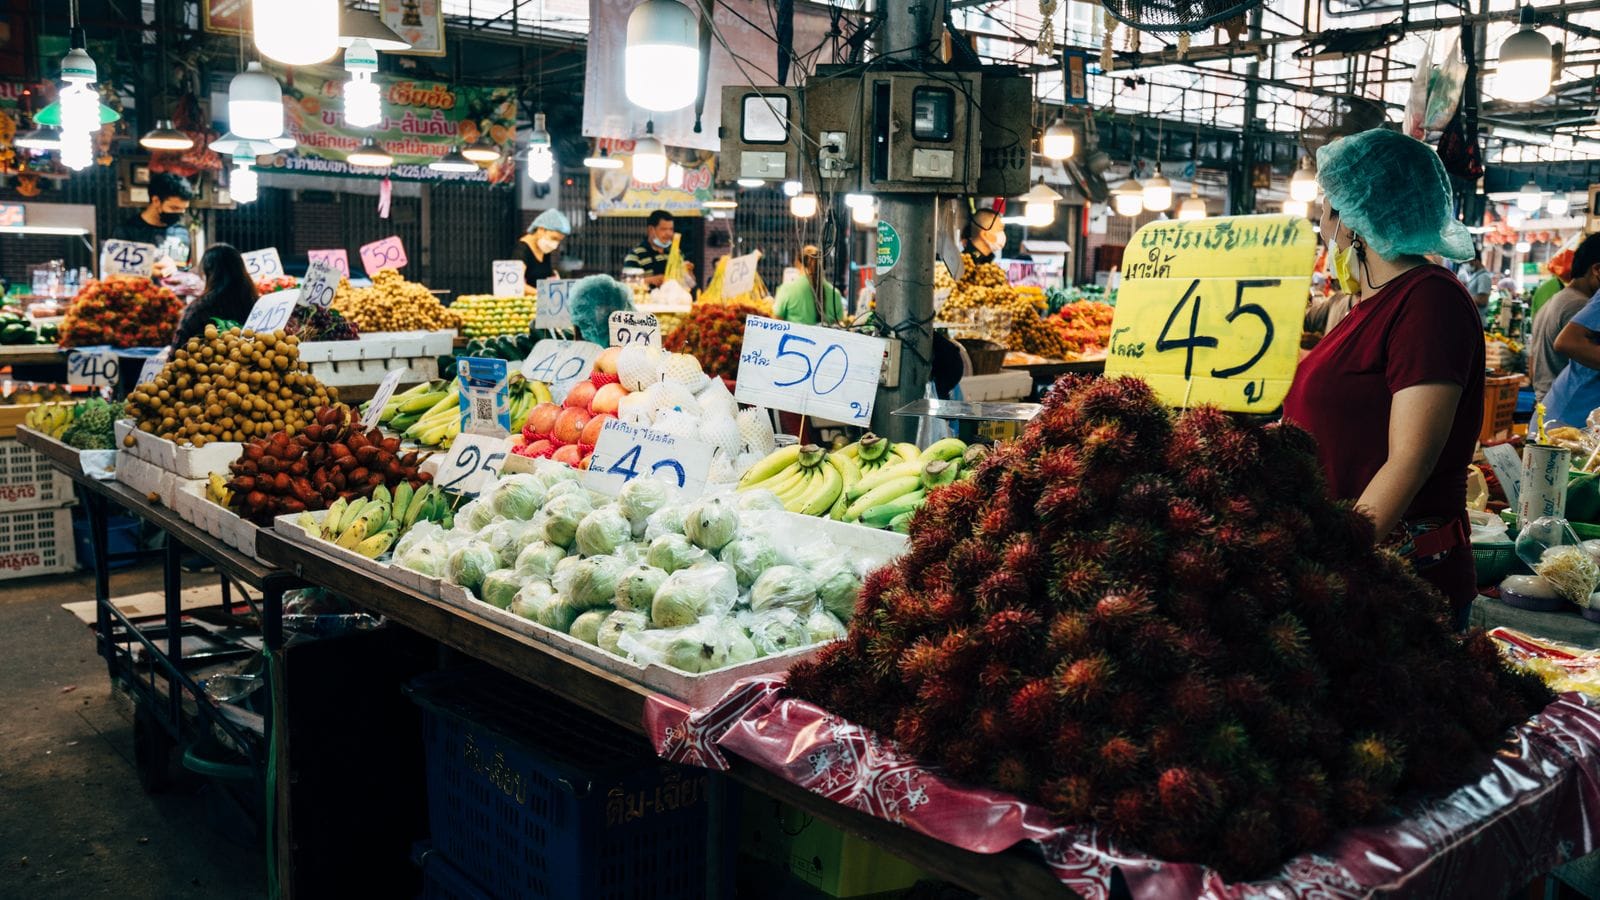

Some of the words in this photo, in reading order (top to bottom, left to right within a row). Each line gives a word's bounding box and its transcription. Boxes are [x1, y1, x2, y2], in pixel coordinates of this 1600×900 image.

[114, 247, 147, 268] 45
[247, 252, 277, 275] 35
[373, 246, 400, 268] 50
[496, 270, 519, 286] 70
[255, 301, 289, 333] 45
[1156, 279, 1282, 381] 45
[81, 355, 118, 385] 40
[532, 352, 585, 381] 40
[774, 333, 849, 395] 50
[850, 401, 870, 418] บ
[441, 445, 506, 497] 25
